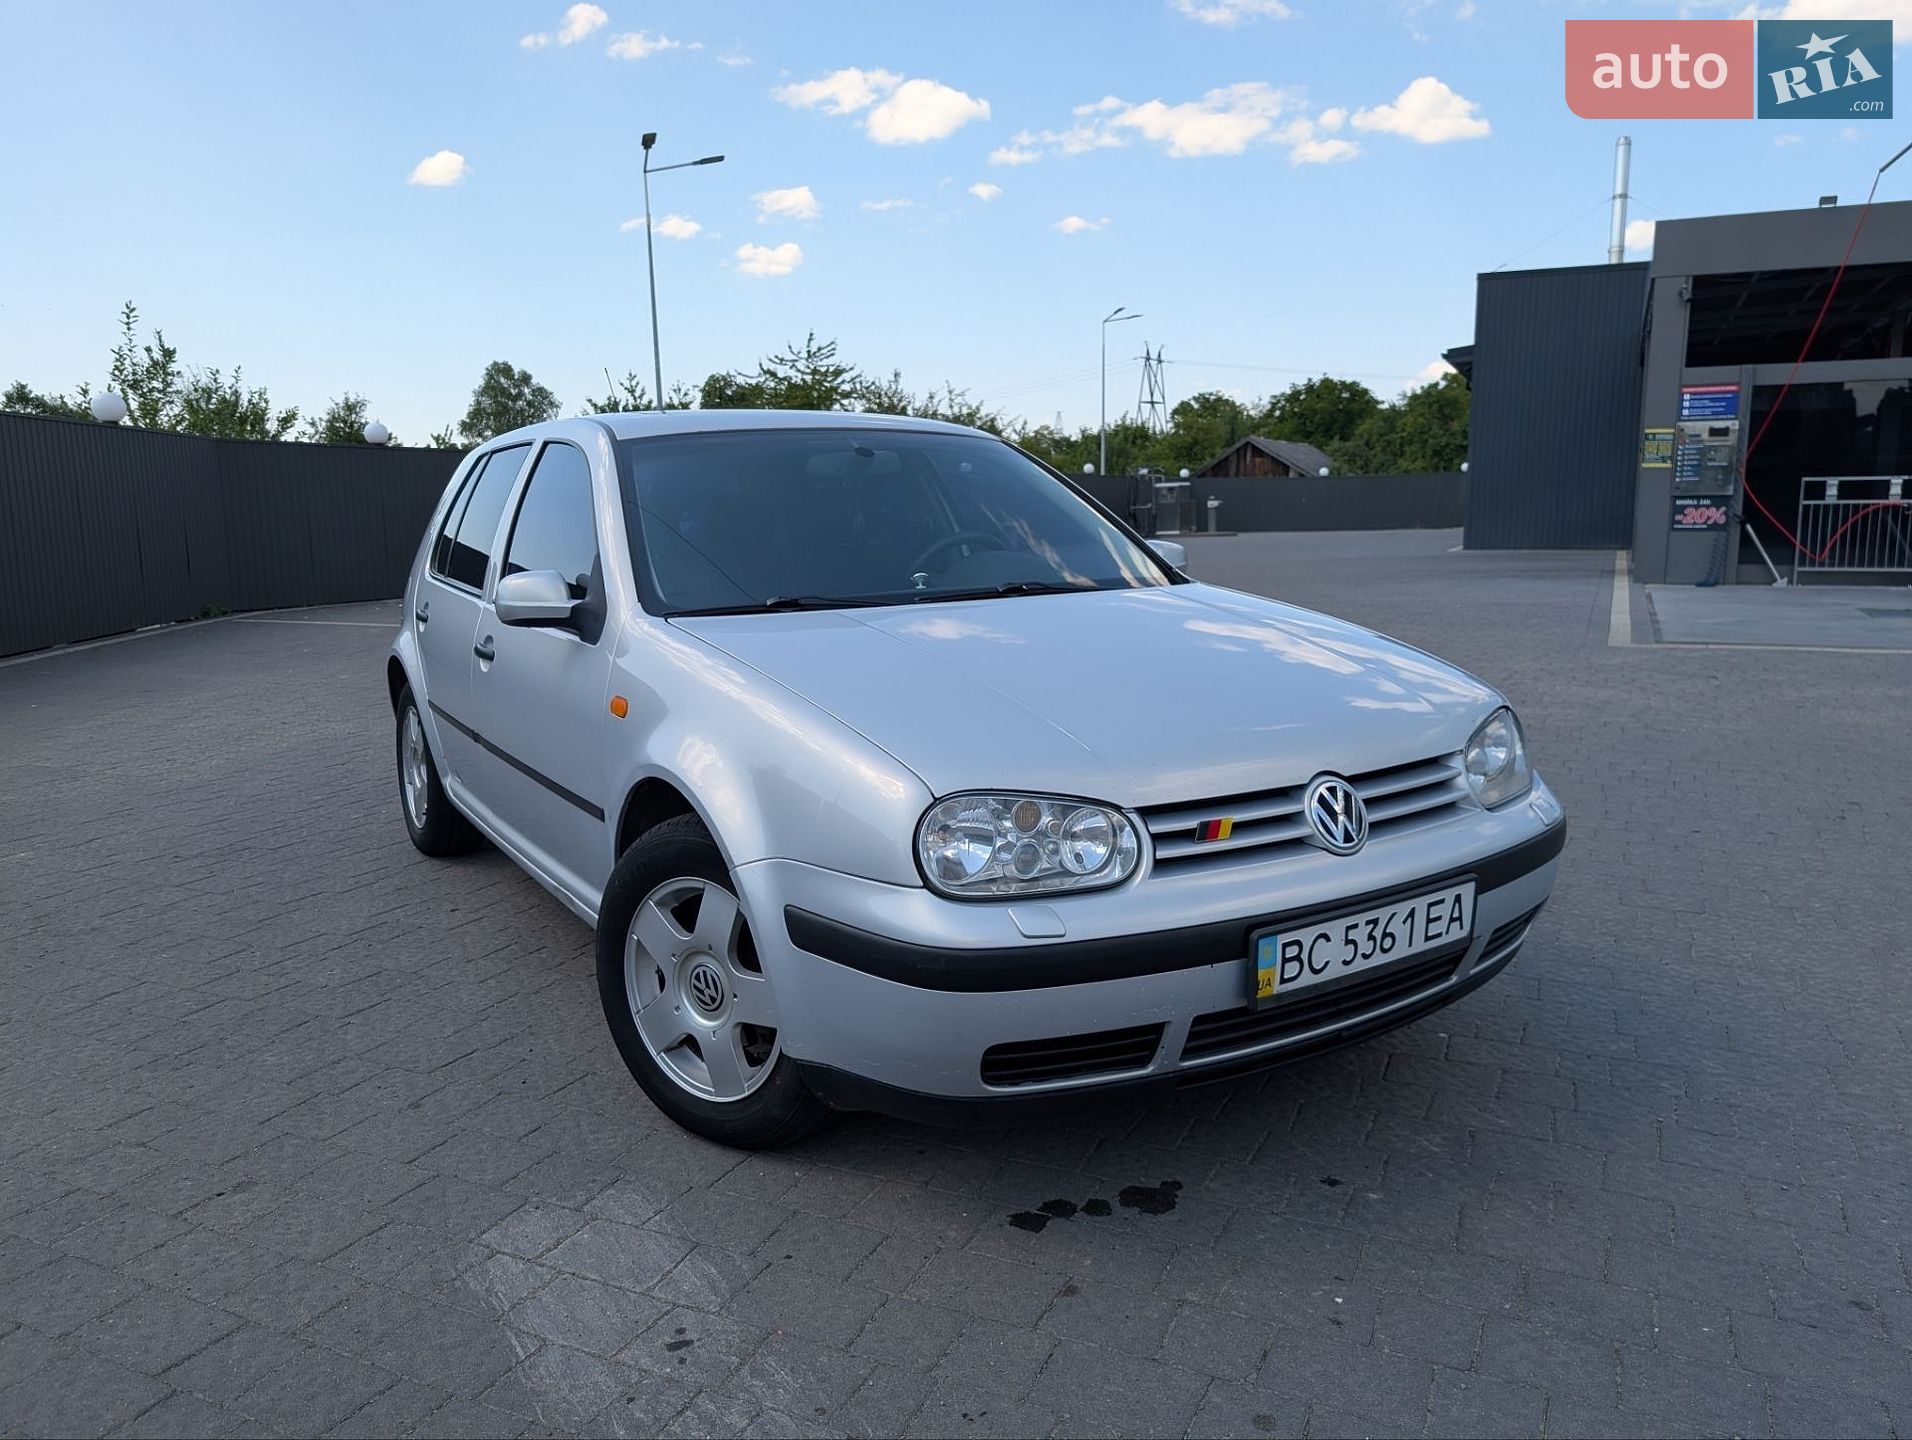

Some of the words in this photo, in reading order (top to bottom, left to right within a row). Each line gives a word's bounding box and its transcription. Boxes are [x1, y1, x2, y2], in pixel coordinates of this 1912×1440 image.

[1279, 932, 1332, 986] BC
[1341, 906, 1416, 967] 5361
[1423, 893, 1464, 943] EA
[1257, 977, 1273, 991] UA
